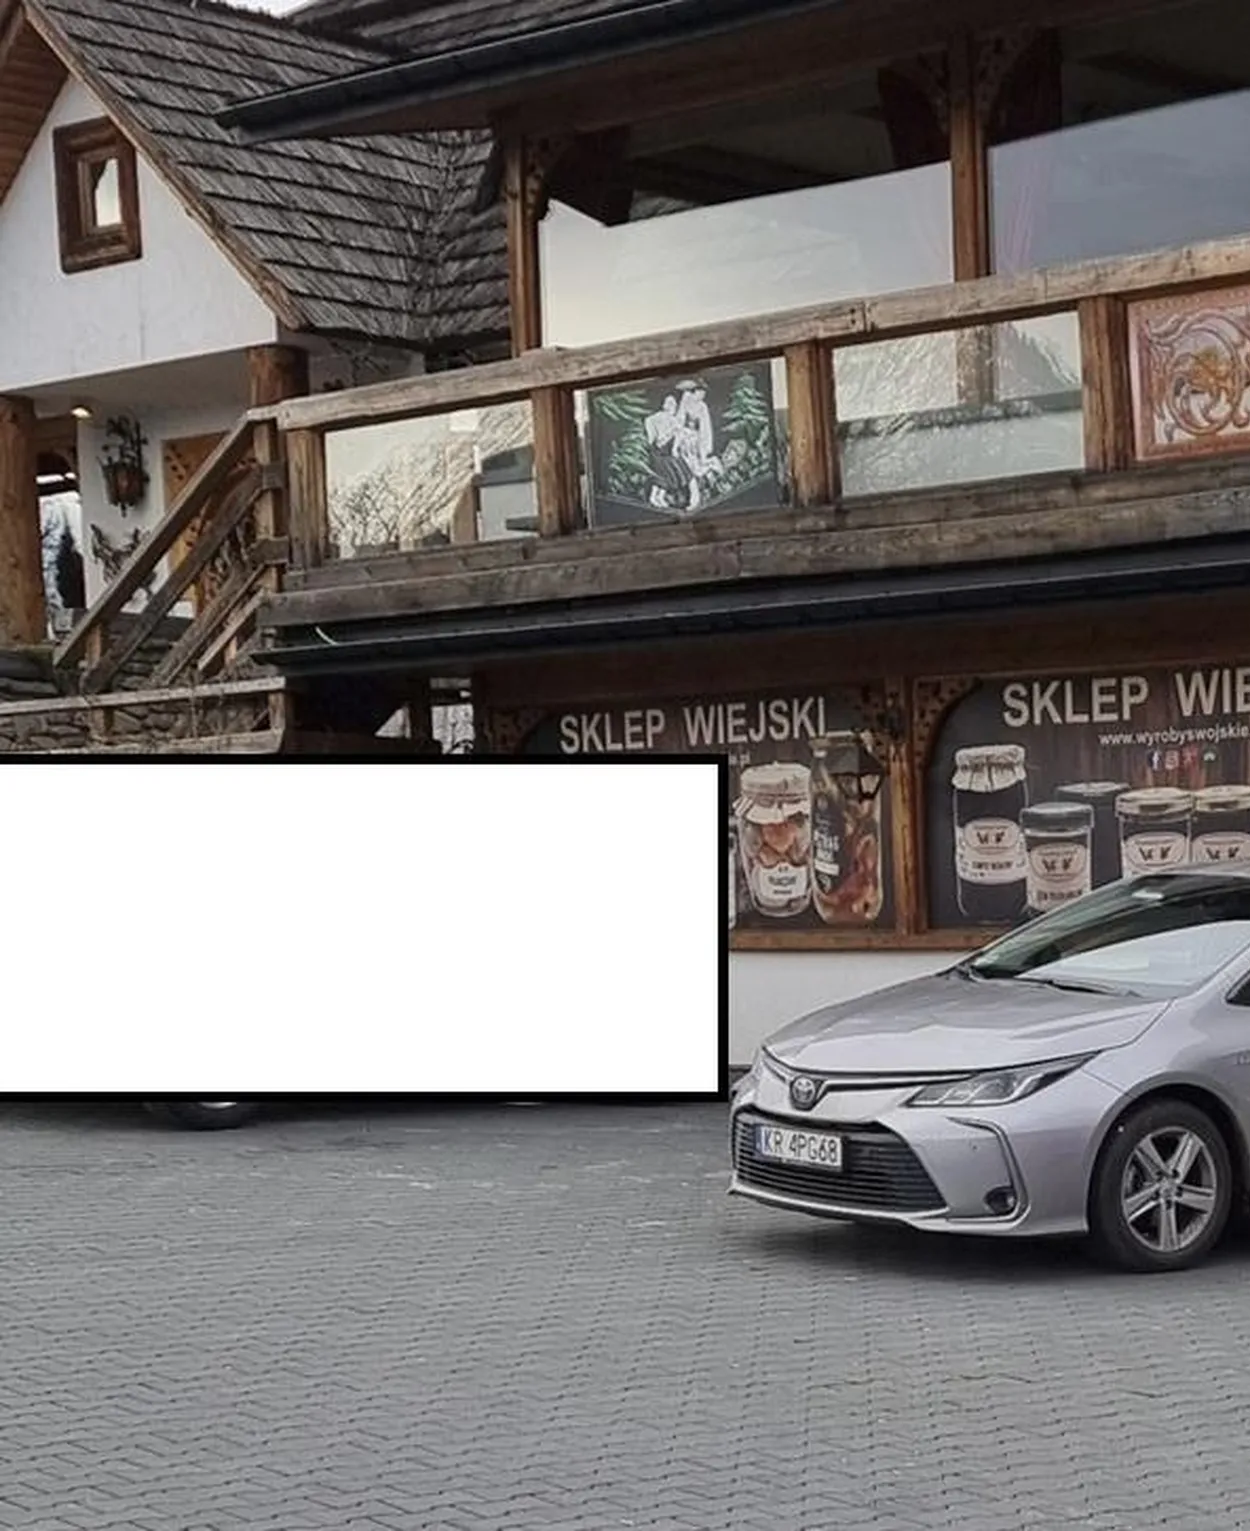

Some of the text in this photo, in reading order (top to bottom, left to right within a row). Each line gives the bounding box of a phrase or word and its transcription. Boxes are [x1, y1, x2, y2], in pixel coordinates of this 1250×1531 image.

[560, 696, 827, 755] SKLEP WIEJSKI
[1002, 675, 1150, 728] SKLEP
[763, 1128, 838, 1163] KR 4PG68
